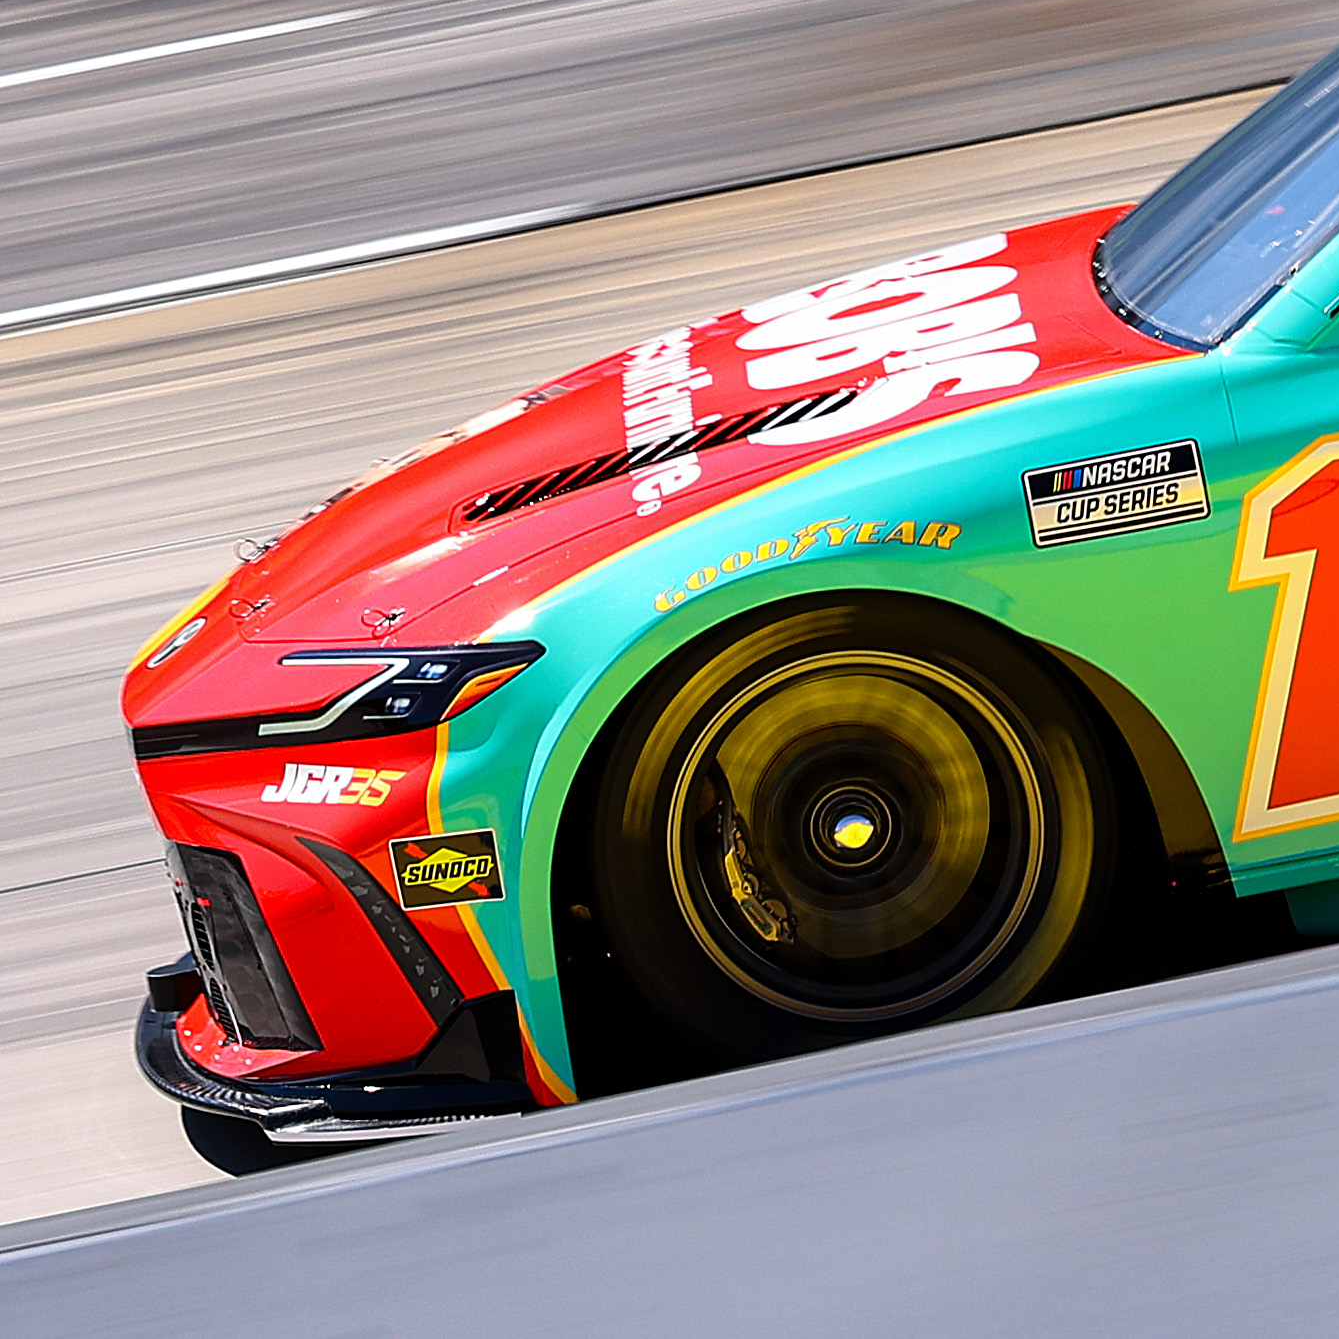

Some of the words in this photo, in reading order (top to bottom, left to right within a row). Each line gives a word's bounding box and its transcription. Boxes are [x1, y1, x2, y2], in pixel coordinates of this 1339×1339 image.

[1082, 451, 1171, 487] NASCAR
[1056, 492, 1100, 524] CUP
[1103, 482, 1180, 517] SERIES
[653, 516, 963, 614] GOODYEAR
[406, 856, 491, 884] SUNOCO
